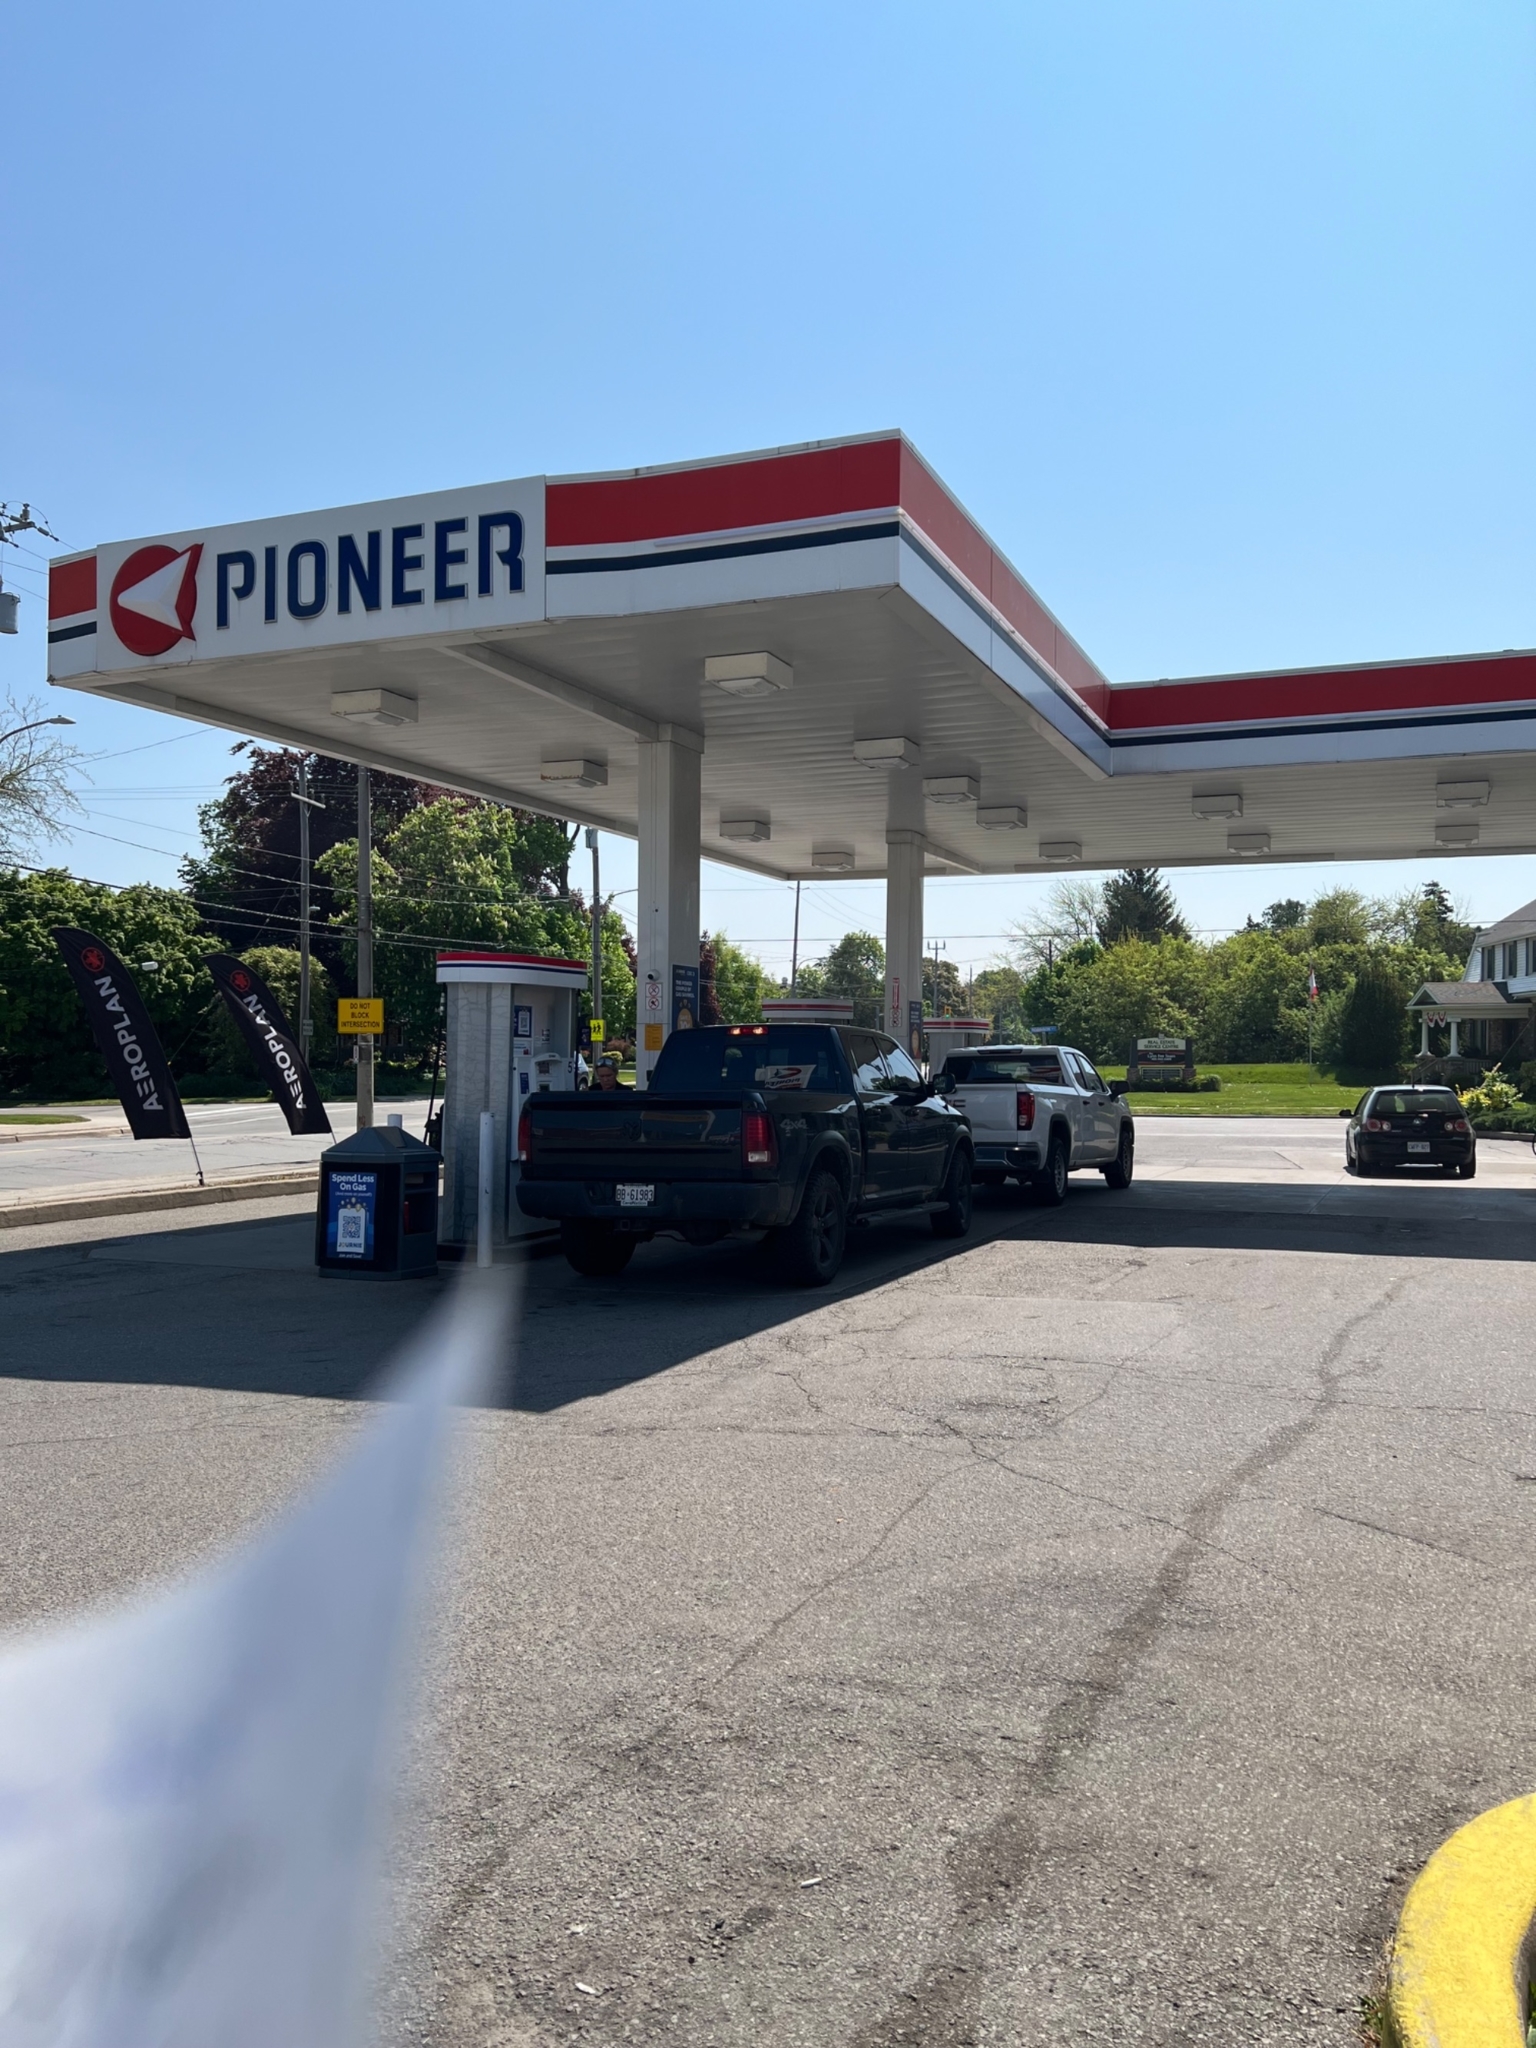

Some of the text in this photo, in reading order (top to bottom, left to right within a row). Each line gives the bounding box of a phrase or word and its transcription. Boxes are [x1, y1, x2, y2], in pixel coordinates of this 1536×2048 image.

[217, 510, 525, 630] PIONEER
[94, 975, 164, 1111] AEROPLAN
[243, 993, 307, 1109] AEROPLAN
[567, 1061, 573, 1074] 5
[332, 1173, 374, 1183] Spend Less
[340, 1183, 367, 1191] On Gas
